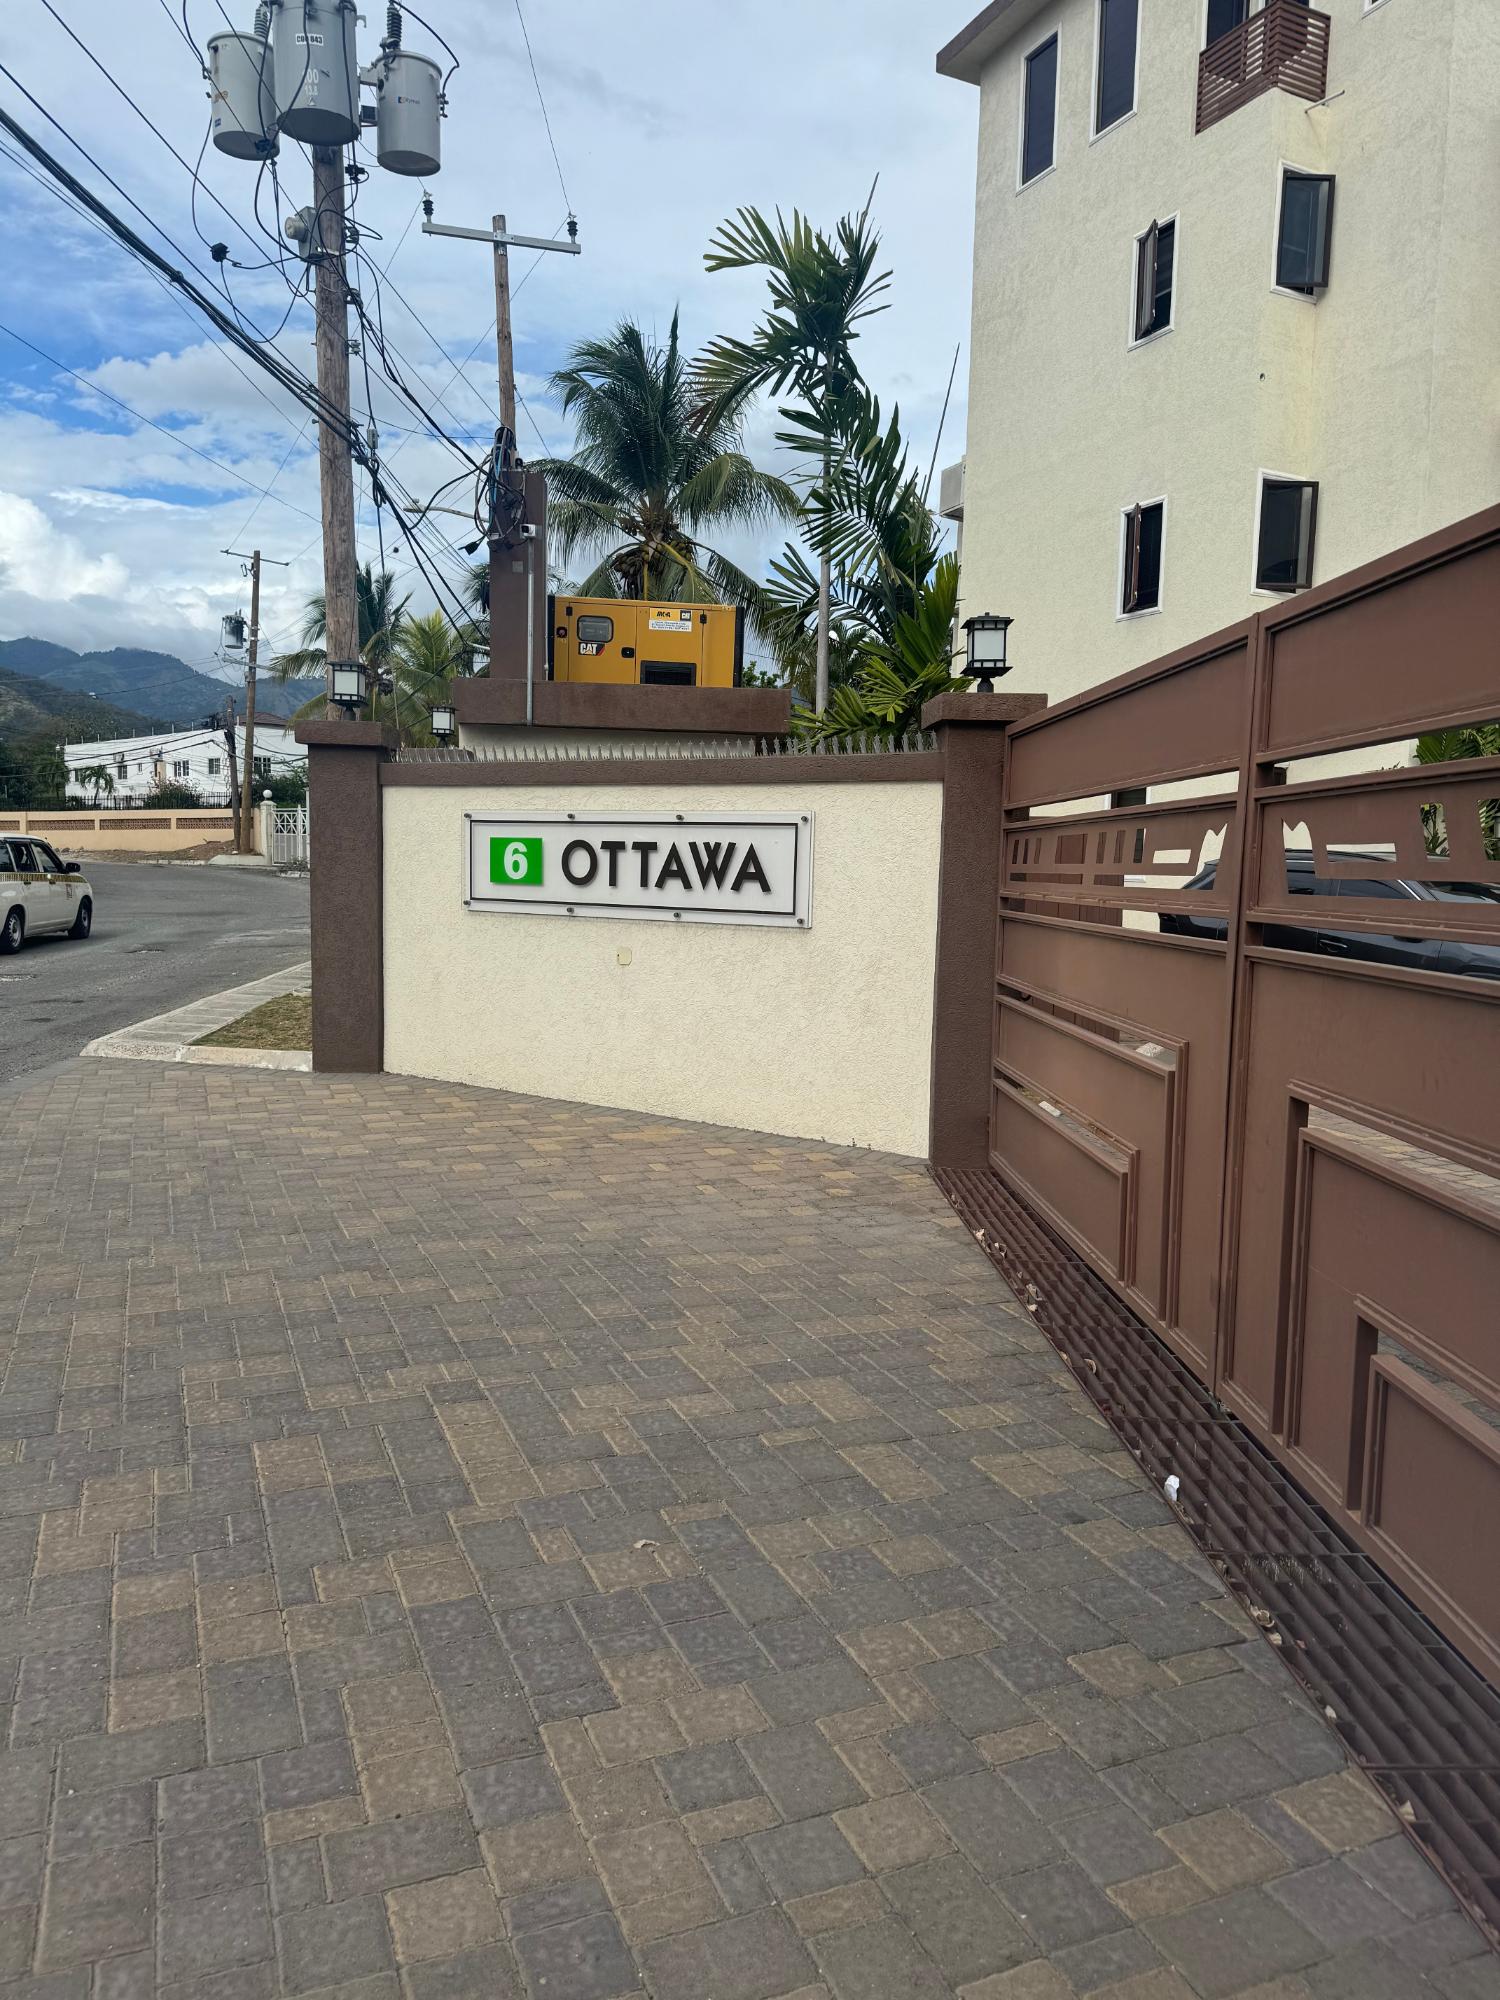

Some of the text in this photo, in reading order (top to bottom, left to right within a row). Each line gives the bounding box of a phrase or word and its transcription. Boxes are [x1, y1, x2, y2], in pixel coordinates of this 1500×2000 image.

[580, 643, 598, 655] CAT
[503, 839, 772, 893] 6 OTTAWA
